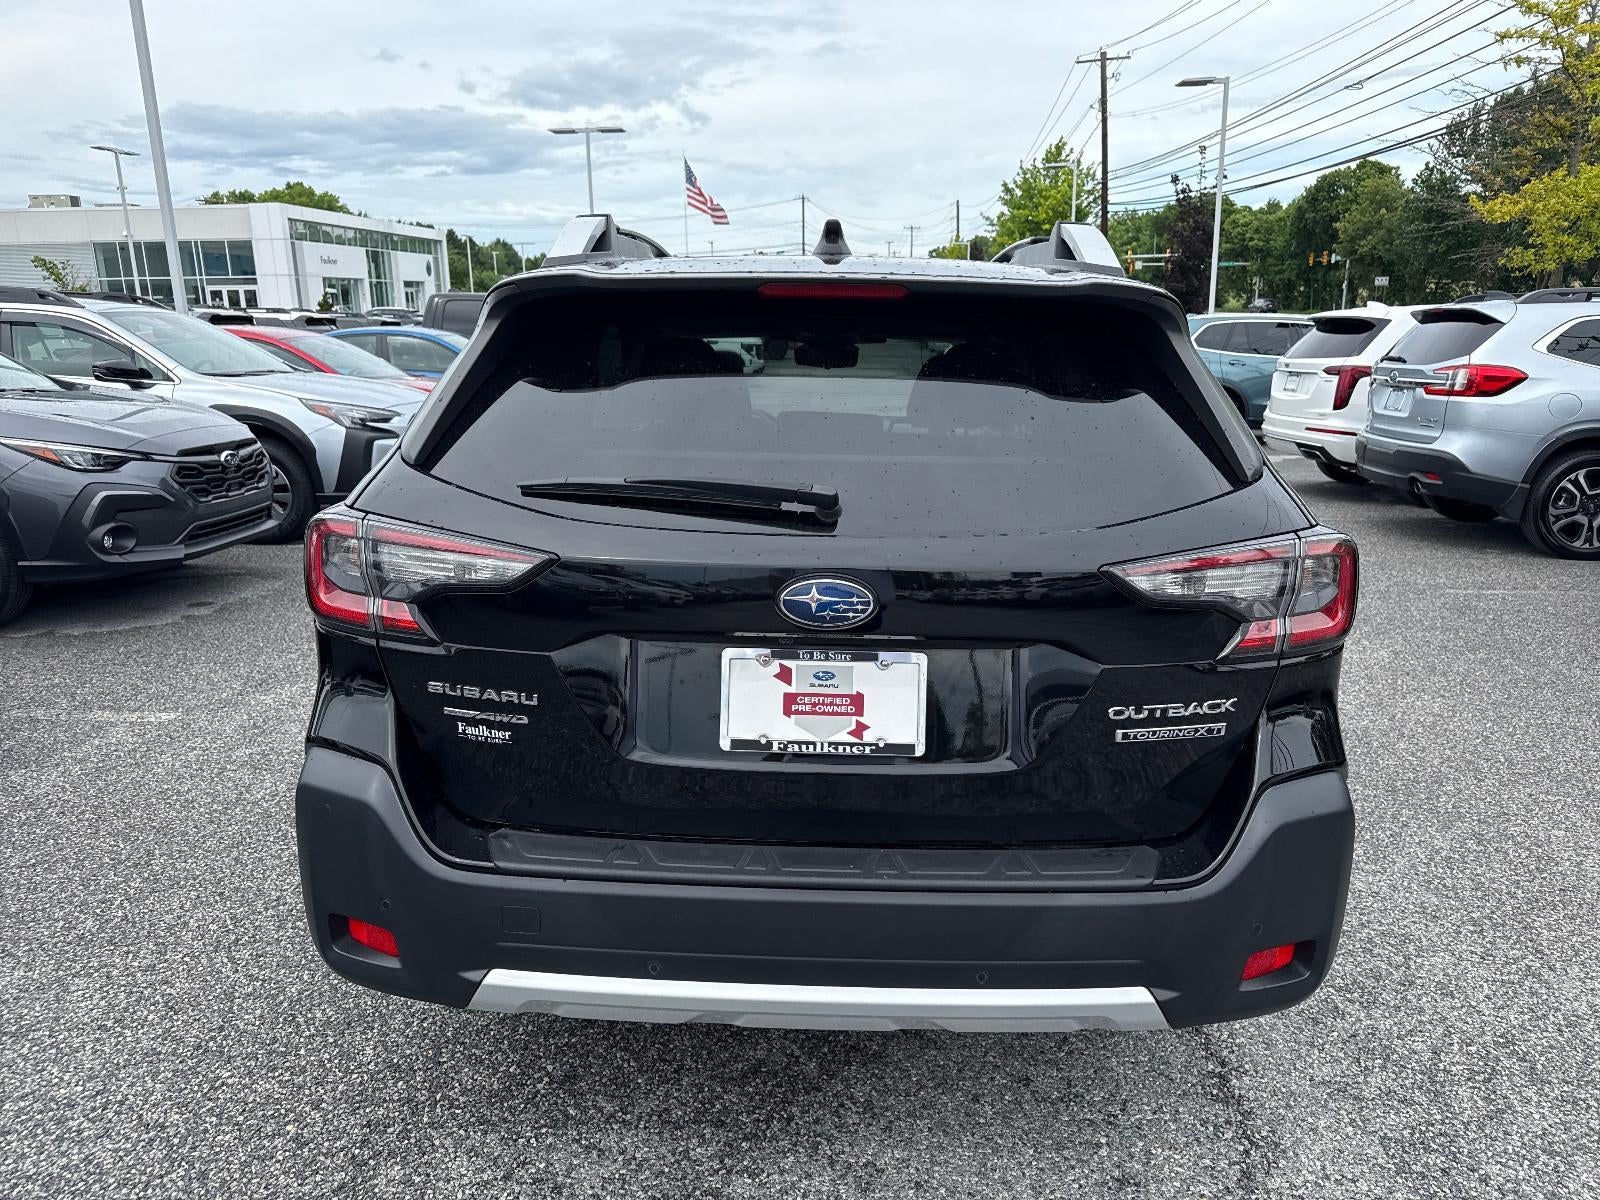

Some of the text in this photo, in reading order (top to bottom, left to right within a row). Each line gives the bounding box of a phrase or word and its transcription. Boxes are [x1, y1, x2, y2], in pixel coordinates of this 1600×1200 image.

[798, 650, 852, 661] To Be Sure
[427, 681, 538, 706] SUBARU
[797, 696, 851, 705] CERTIFIED
[791, 705, 855, 713] PRE-OWNED
[1107, 697, 1238, 720] OUTBACK
[474, 711, 529, 724] AWD
[457, 721, 512, 740] Faulkner
[770, 740, 876, 754] Faulkner
